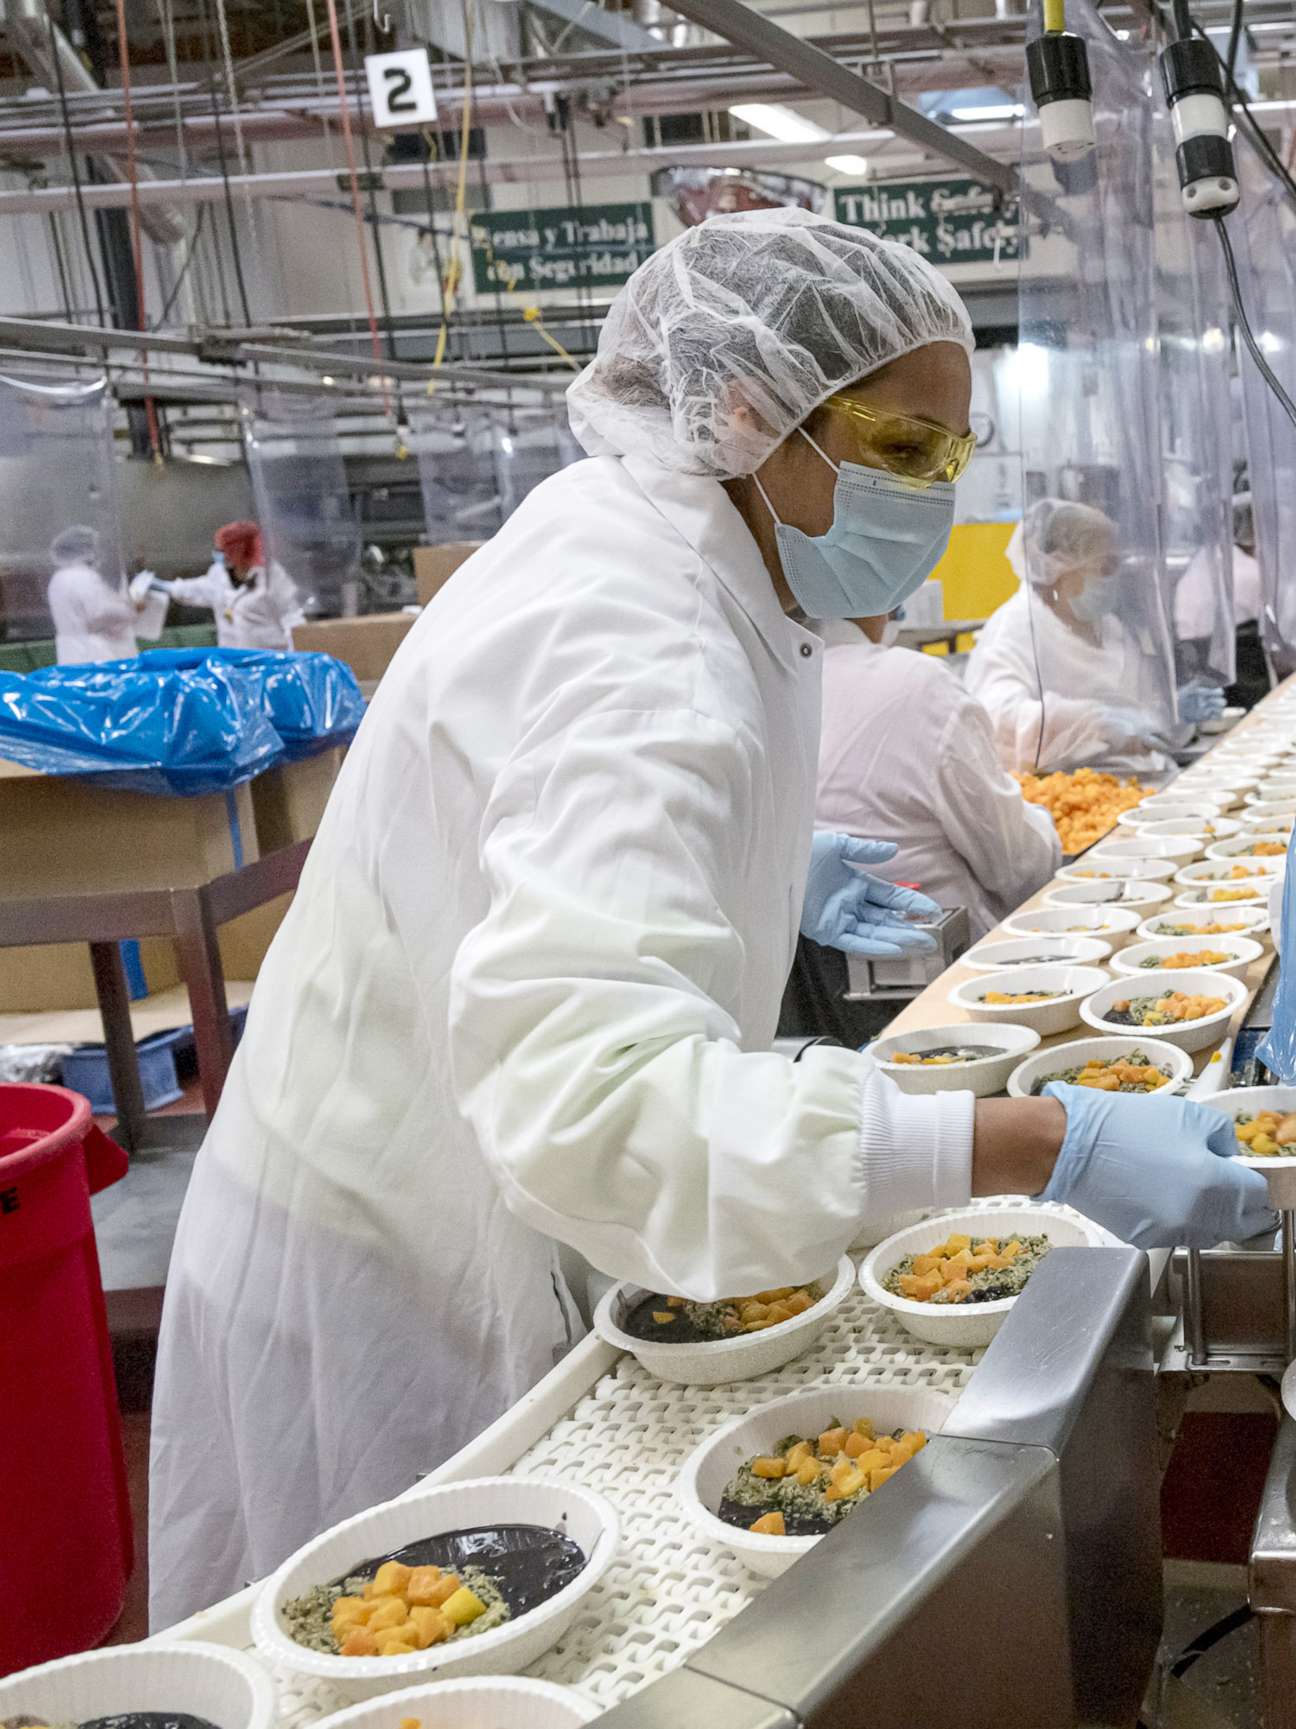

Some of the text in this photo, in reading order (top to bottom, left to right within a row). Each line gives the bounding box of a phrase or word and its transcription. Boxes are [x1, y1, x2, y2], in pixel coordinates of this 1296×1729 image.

[384, 67, 417, 113] 2
[838, 185, 1018, 223] Think Sfy
[561, 217, 649, 246] Trabaja
[875, 220, 931, 253] ork
